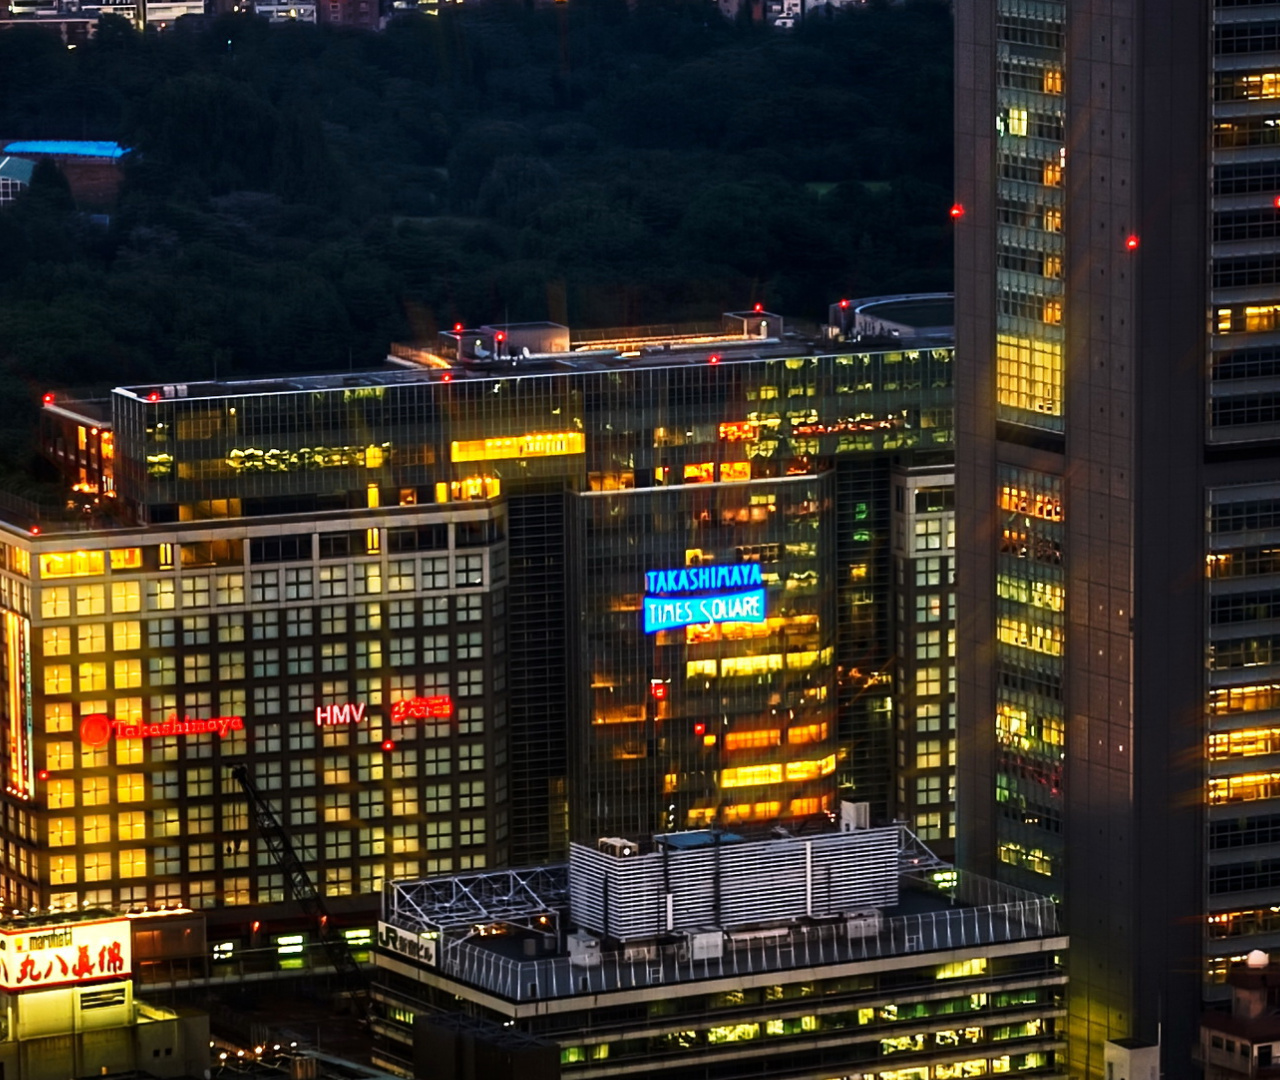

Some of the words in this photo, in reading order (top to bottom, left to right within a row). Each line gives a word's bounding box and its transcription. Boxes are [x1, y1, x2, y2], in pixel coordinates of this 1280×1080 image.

[647, 563, 762, 594] TAKASHIMAYA
[649, 601, 693, 624] TIMES
[700, 595, 761, 632] SQUARE
[111, 713, 244, 739] Takashimaya
